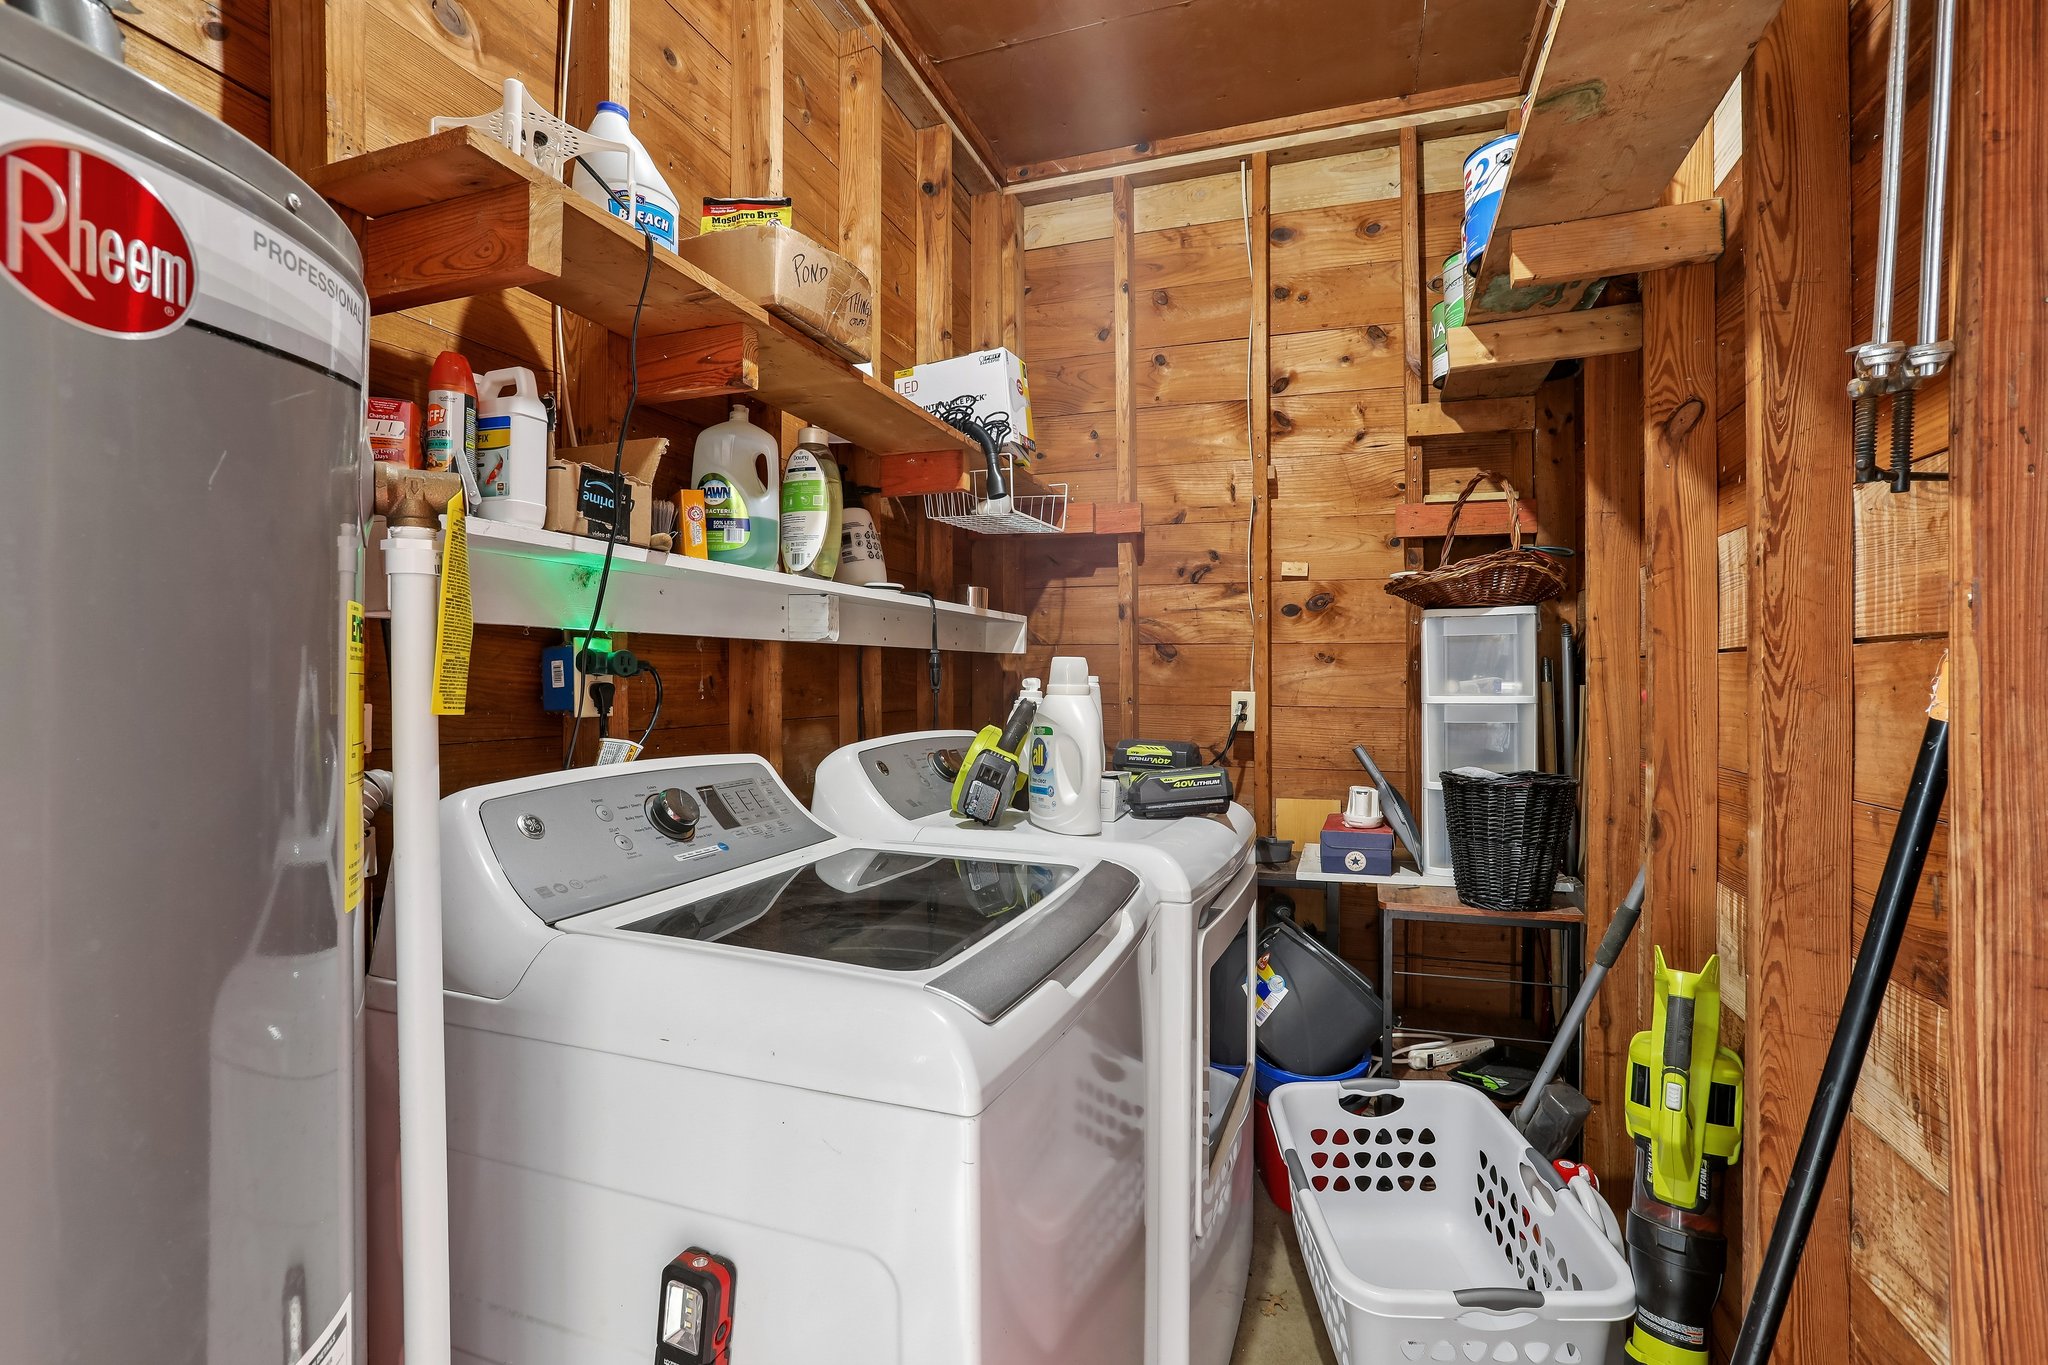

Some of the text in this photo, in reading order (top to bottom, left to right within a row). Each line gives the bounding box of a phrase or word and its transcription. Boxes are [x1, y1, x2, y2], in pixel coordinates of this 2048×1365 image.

[618, 208, 669, 232] BEACH
[711, 210, 779, 224] MOSQUITO BITS
[6, 149, 188, 308] Rheem
[253, 231, 363, 326] PROFESSIONAL
[792, 253, 829, 288] POND
[897, 380, 919, 394] LED
[368, 412, 389, 420] Change
[428, 408, 446, 423] FF!
[582, 490, 615, 509] prime
[700, 486, 731, 499] DAWN
[1033, 744, 1044, 766] all
[1173, 779, 1220, 788] 40V LITHIUM
[1699, 1167, 1708, 1200] JET FAN
